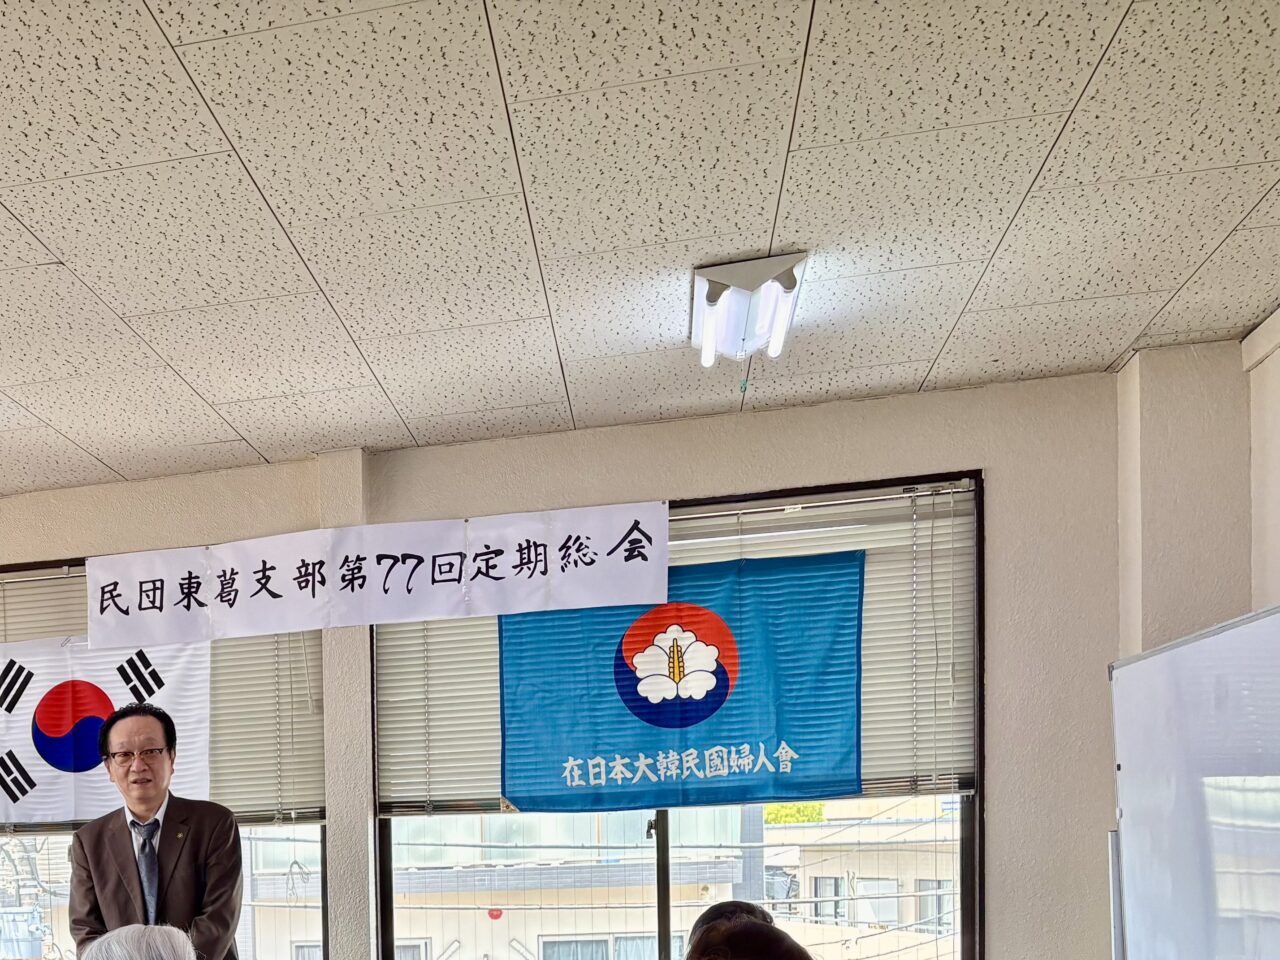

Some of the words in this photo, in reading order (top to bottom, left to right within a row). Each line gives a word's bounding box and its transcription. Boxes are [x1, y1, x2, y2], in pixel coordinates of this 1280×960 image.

[98, 519, 653, 617] 民団東葛支部第77回定期総会
[561, 740, 800, 787] 在日本大韓民國婦人會
